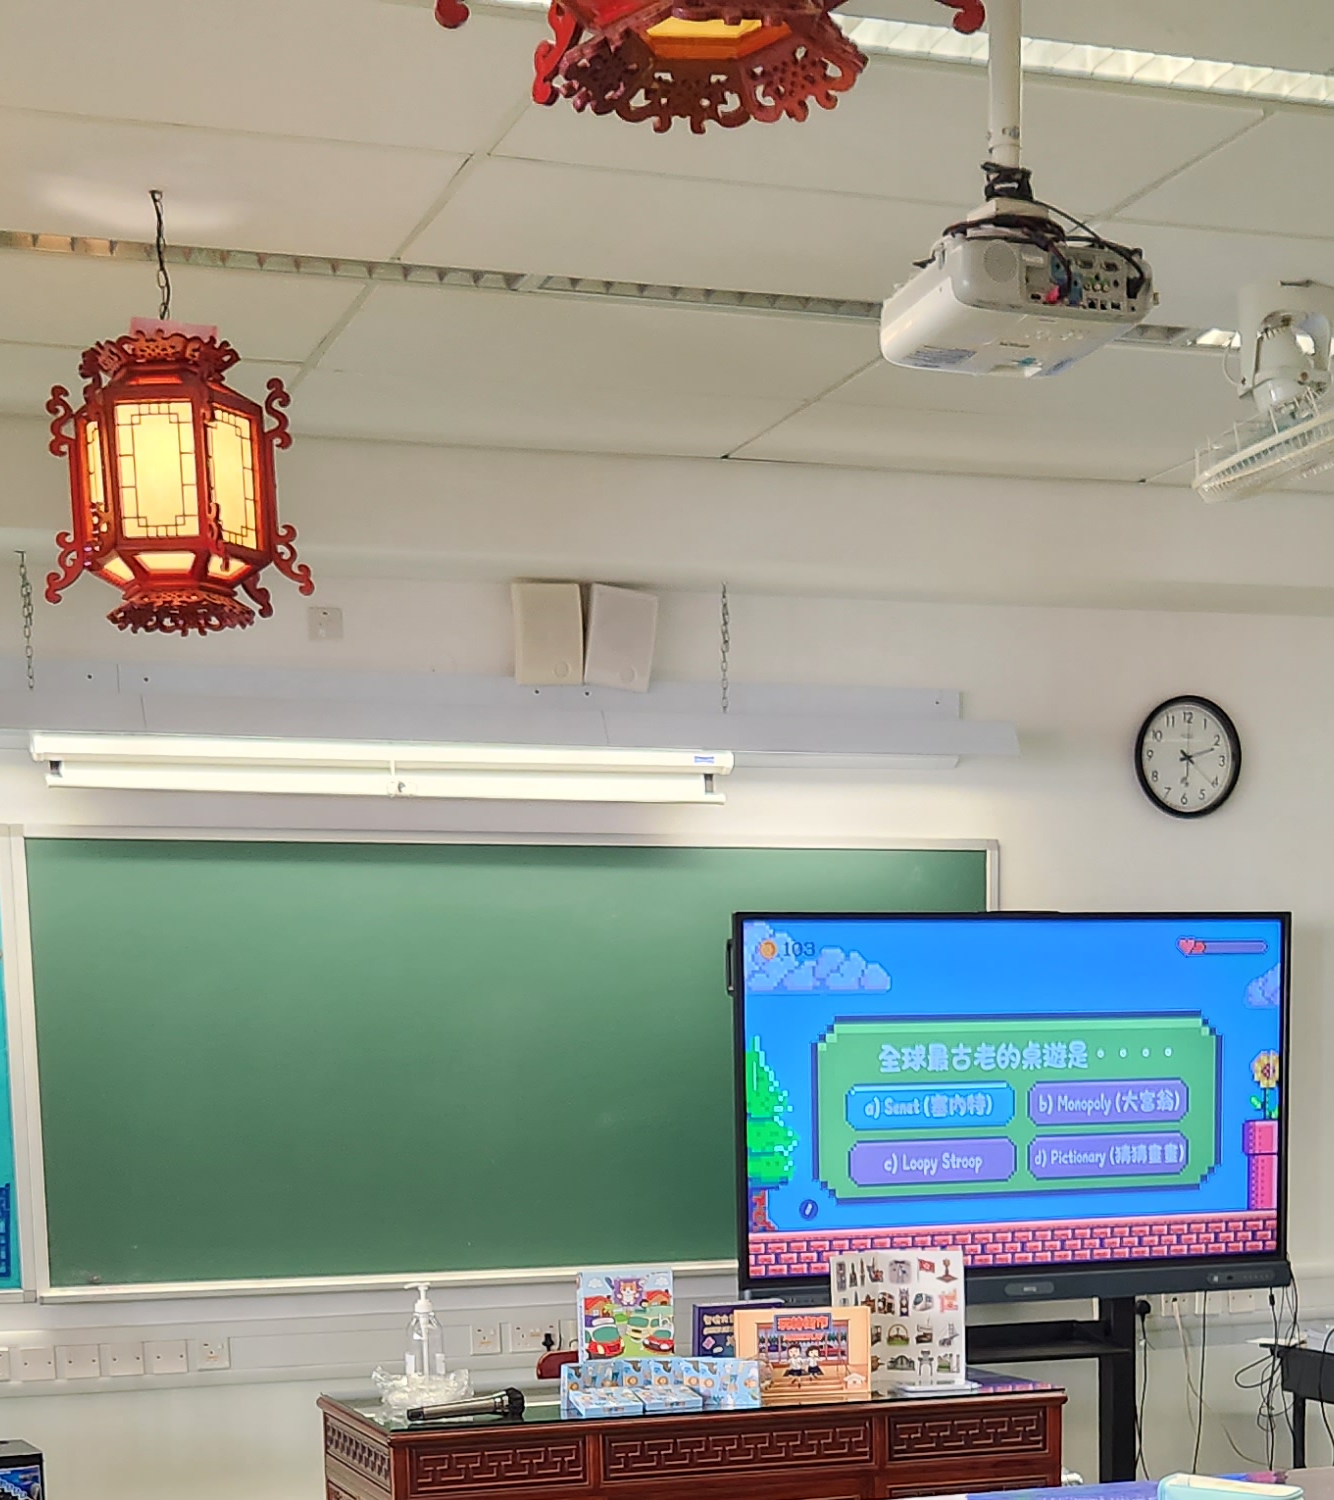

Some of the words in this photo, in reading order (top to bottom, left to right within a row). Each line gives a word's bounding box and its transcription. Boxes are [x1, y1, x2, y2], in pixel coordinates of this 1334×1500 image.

[1165, 715, 1175, 728] 11
[1183, 711, 1193, 724] 12
[1152, 730, 1162, 742] 10
[1214, 735, 1221, 746] 2
[1147, 749, 1153, 761] 9
[1218, 755, 1225, 767] 3
[1152, 770, 1158, 782] 8
[1180, 793, 1188, 805] 6
[1198, 789, 1205, 800] 5
[784, 941, 815, 957] 103
[865, 1096, 880, 1120] a)
[1039, 1094, 1053, 1115] b)
[1057, 1092, 1111, 1116] Monopoly
[884, 1153, 898, 1175] c)
[903, 1153, 938, 1176] Loopy
[942, 1152, 983, 1174] Stroop
[1034, 1149, 1047, 1168] d)
[1051, 1148, 1106, 1168] Pictionary
